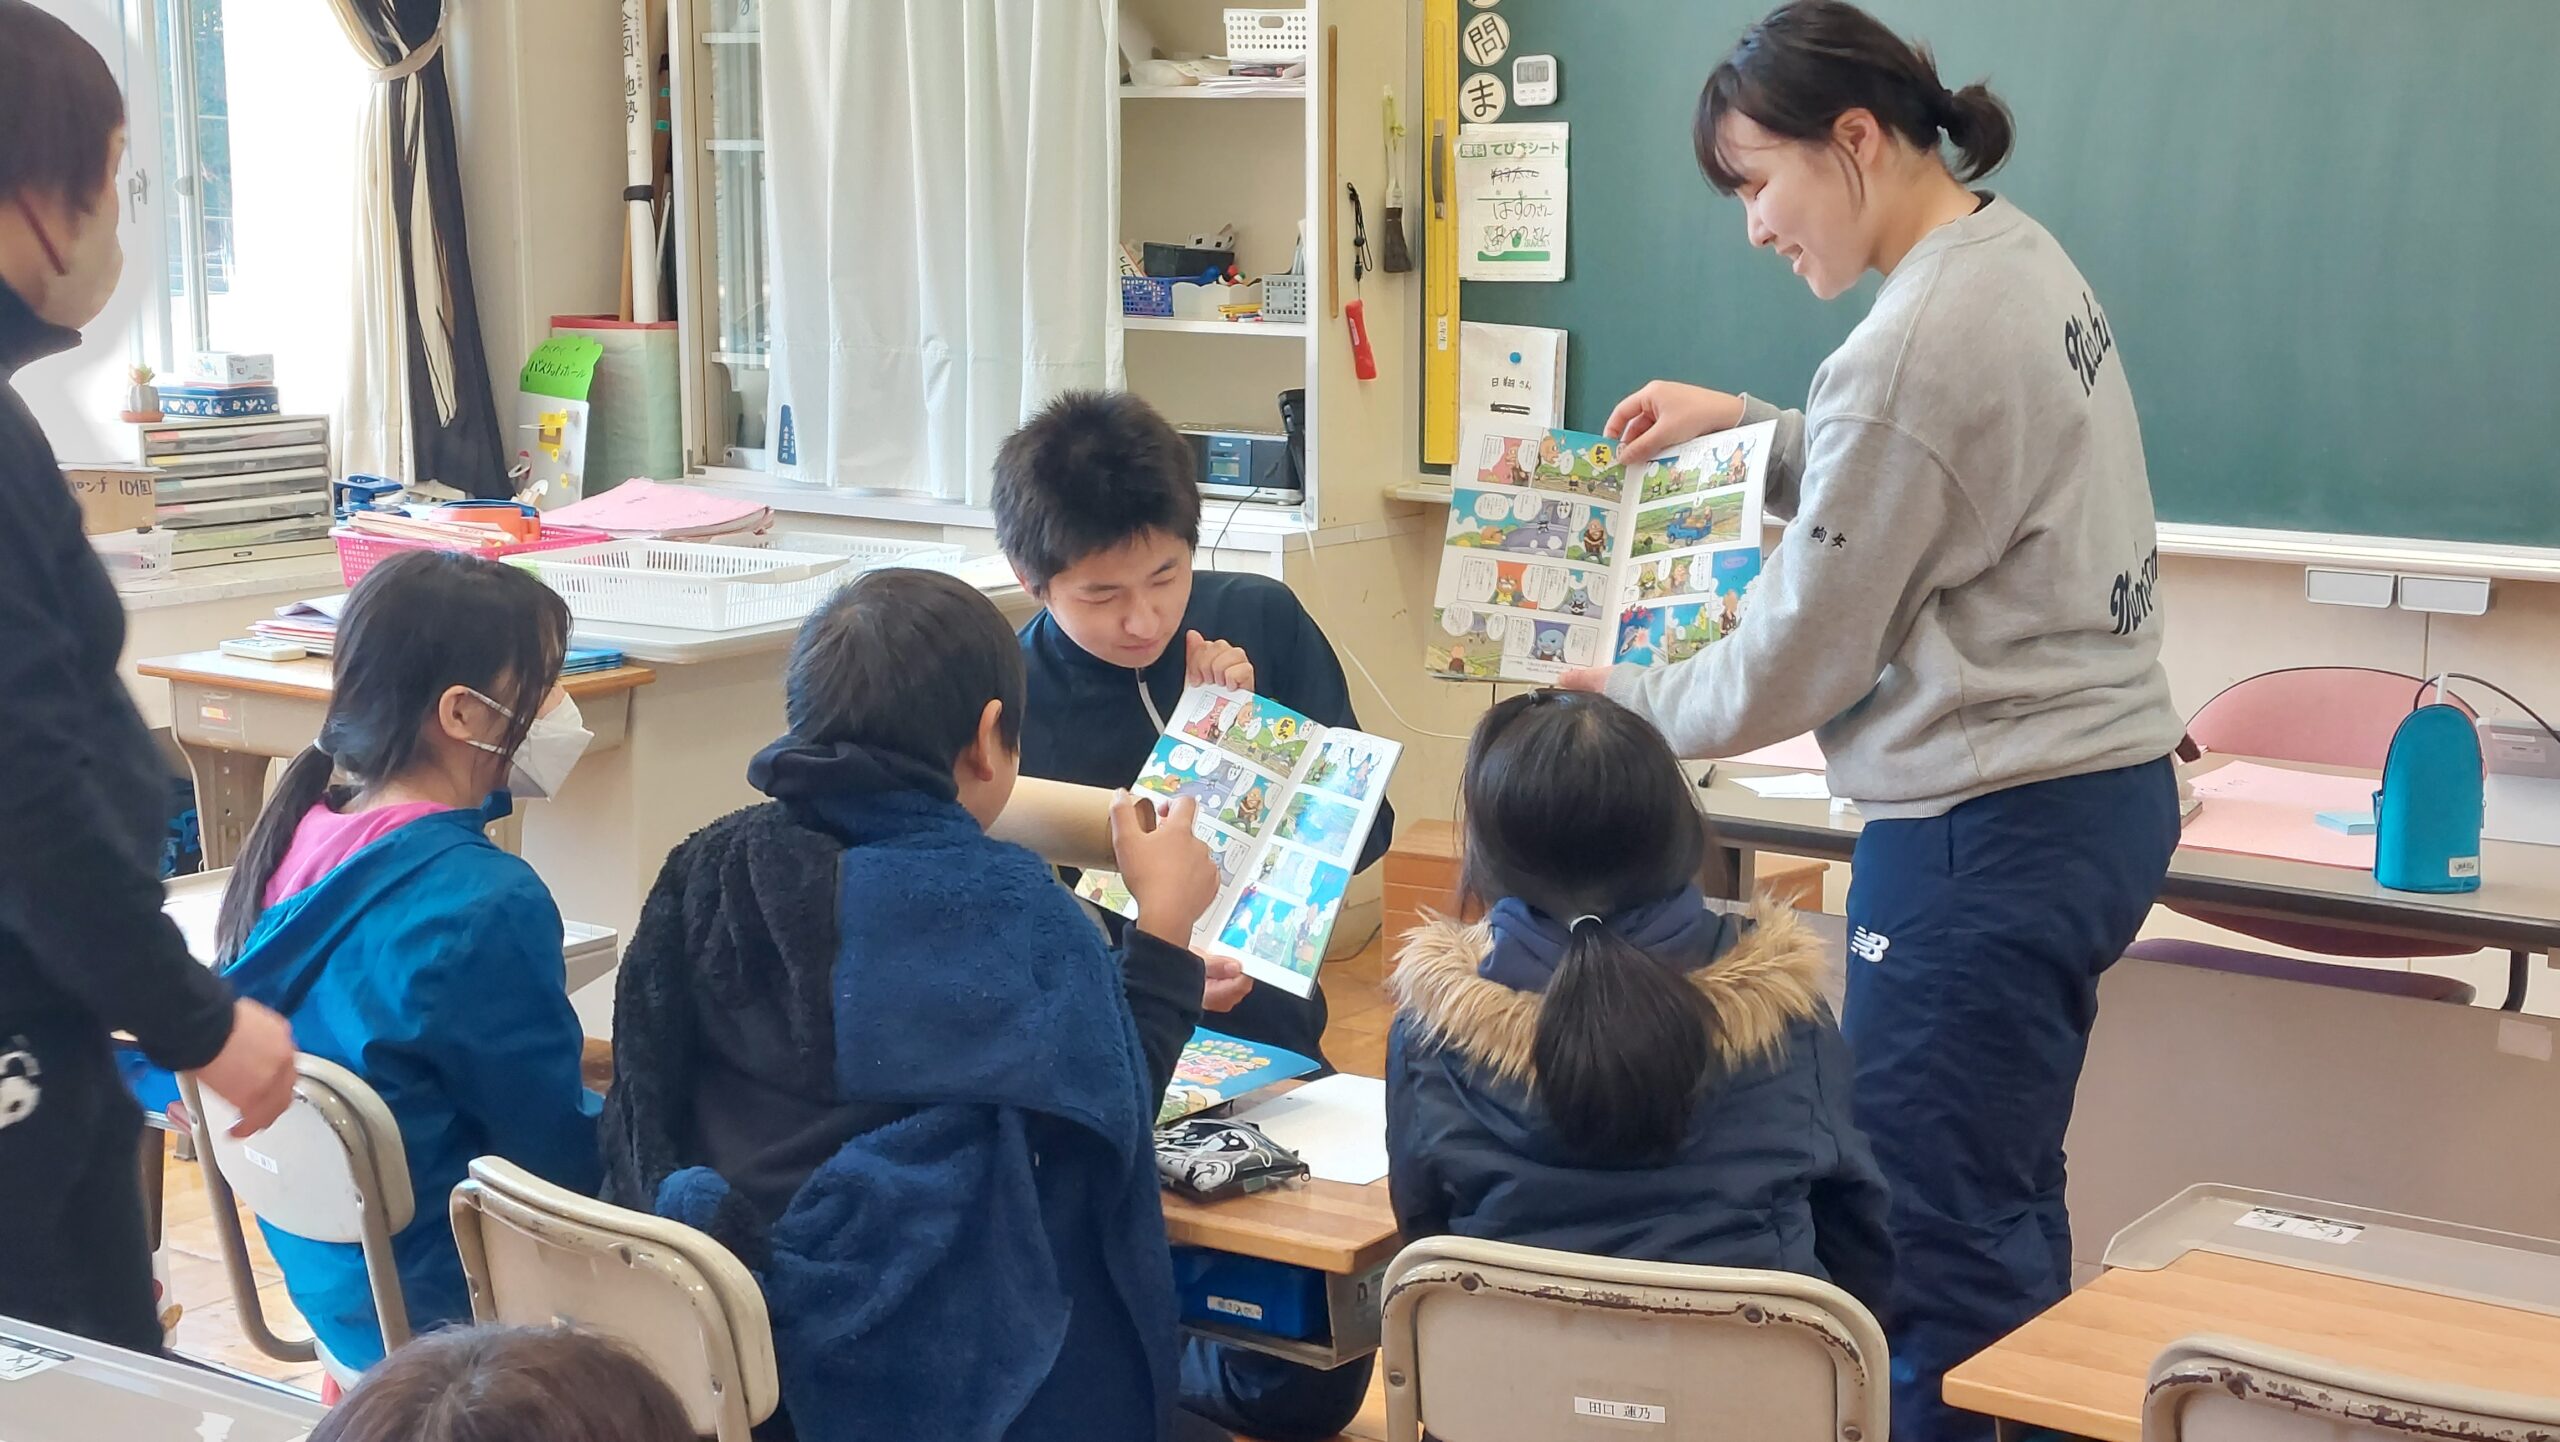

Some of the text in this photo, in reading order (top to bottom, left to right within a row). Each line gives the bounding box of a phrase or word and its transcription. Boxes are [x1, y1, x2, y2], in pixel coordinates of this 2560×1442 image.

[1468, 16, 1506, 64] 問
[1467, 79, 1497, 117] ま
[1589, 1401, 1650, 1419] 田口 蓮乃
